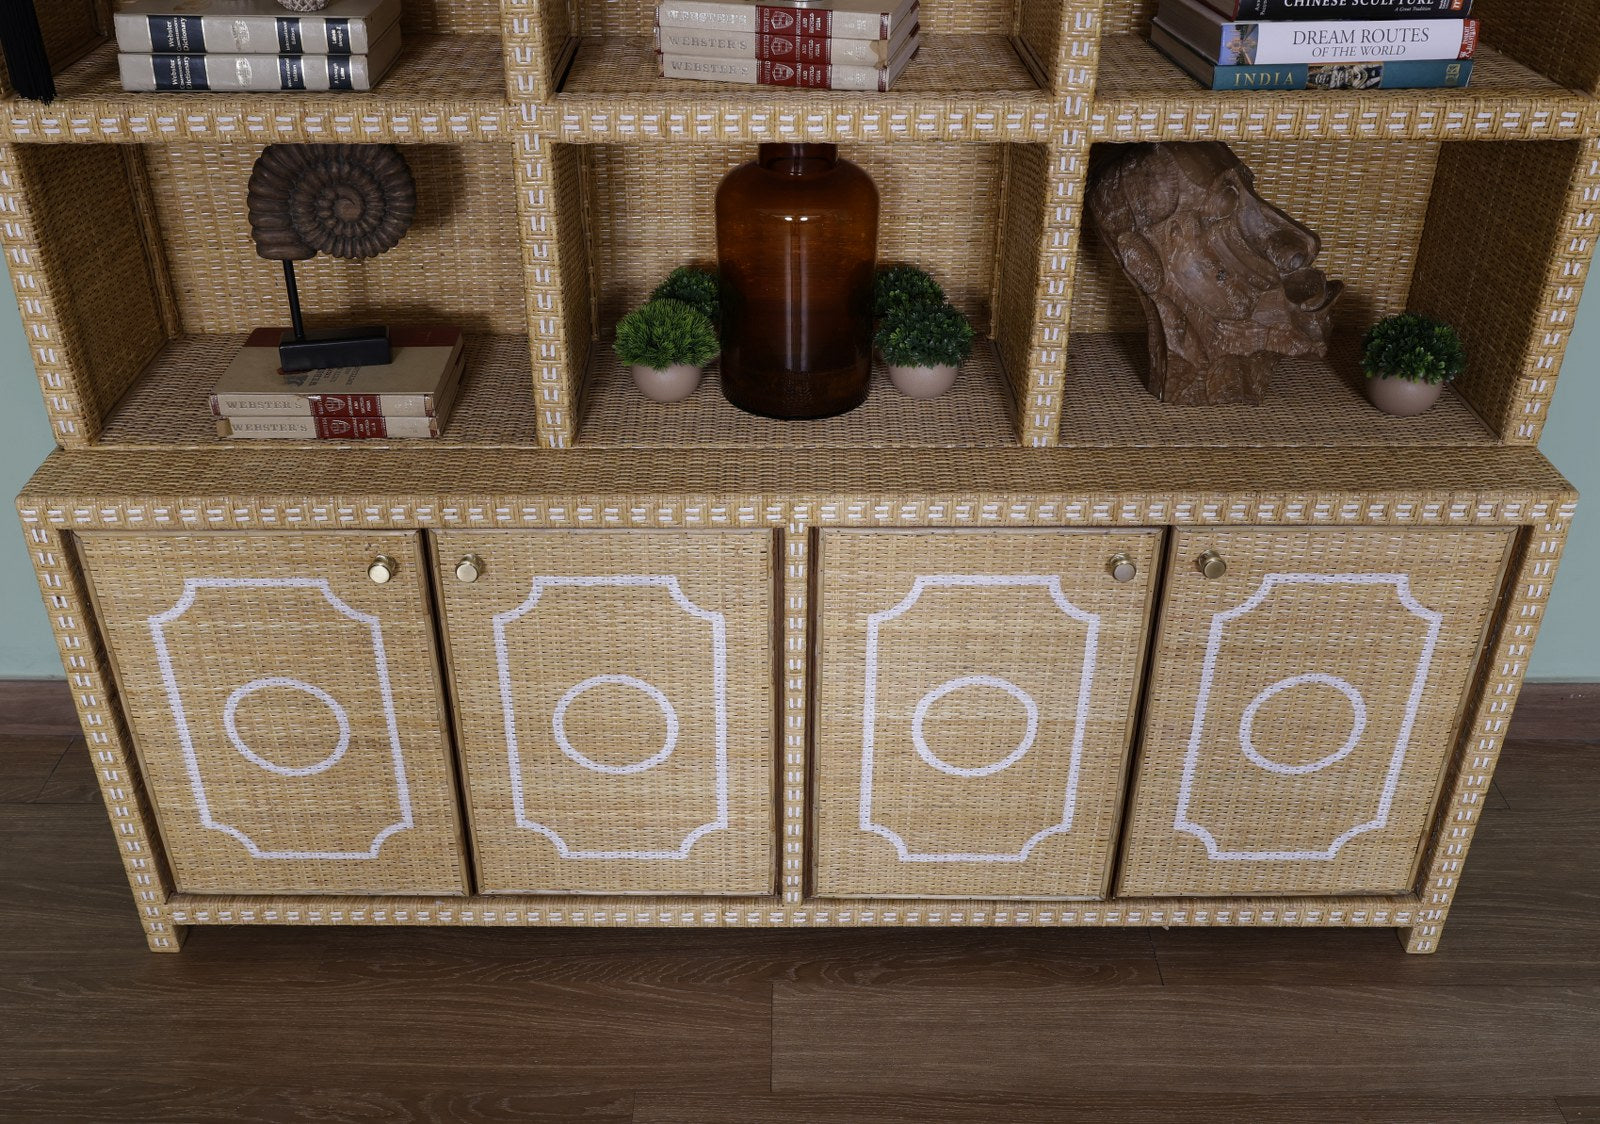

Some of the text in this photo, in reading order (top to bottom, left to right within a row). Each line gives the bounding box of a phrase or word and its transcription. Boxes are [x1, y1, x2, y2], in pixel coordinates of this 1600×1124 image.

[166, 21, 175, 47] Webster
[180, 17, 189, 51] Dictionary
[1293, 27, 1430, 46] DREAM ROUTES
[1312, 44, 1406, 58] OF THE WORLD
[170, 59, 178, 86] Webster
[183, 56, 193, 89] Dictionary
[1234, 71, 1295, 87] INDIA
[232, 423, 308, 432] WEBSTER'S
